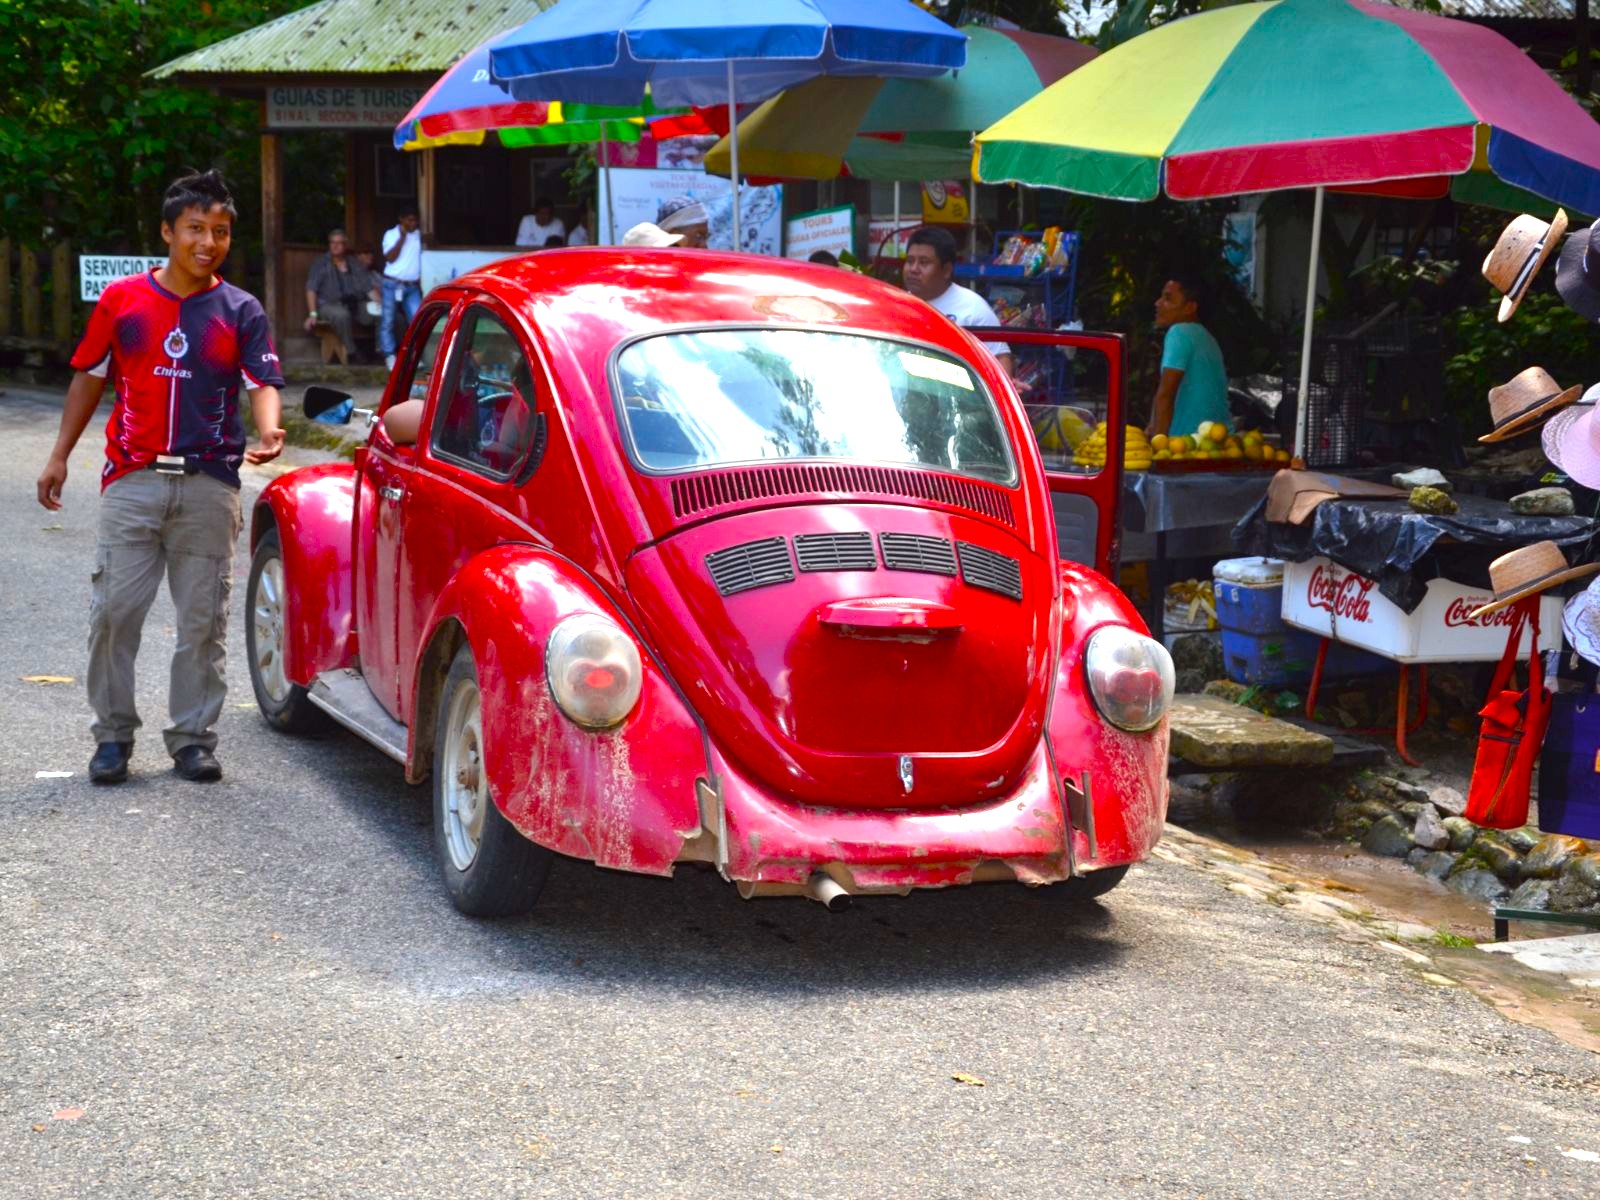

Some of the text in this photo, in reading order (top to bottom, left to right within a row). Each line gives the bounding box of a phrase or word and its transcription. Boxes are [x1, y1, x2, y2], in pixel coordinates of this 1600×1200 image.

[273, 88, 422, 107] GUIAS DE TURIST
[802, 215, 833, 228] TOURS
[84, 259, 143, 275] SERVICIO
[85, 280, 110, 296] PAS
[153, 366, 193, 379] Chivas
